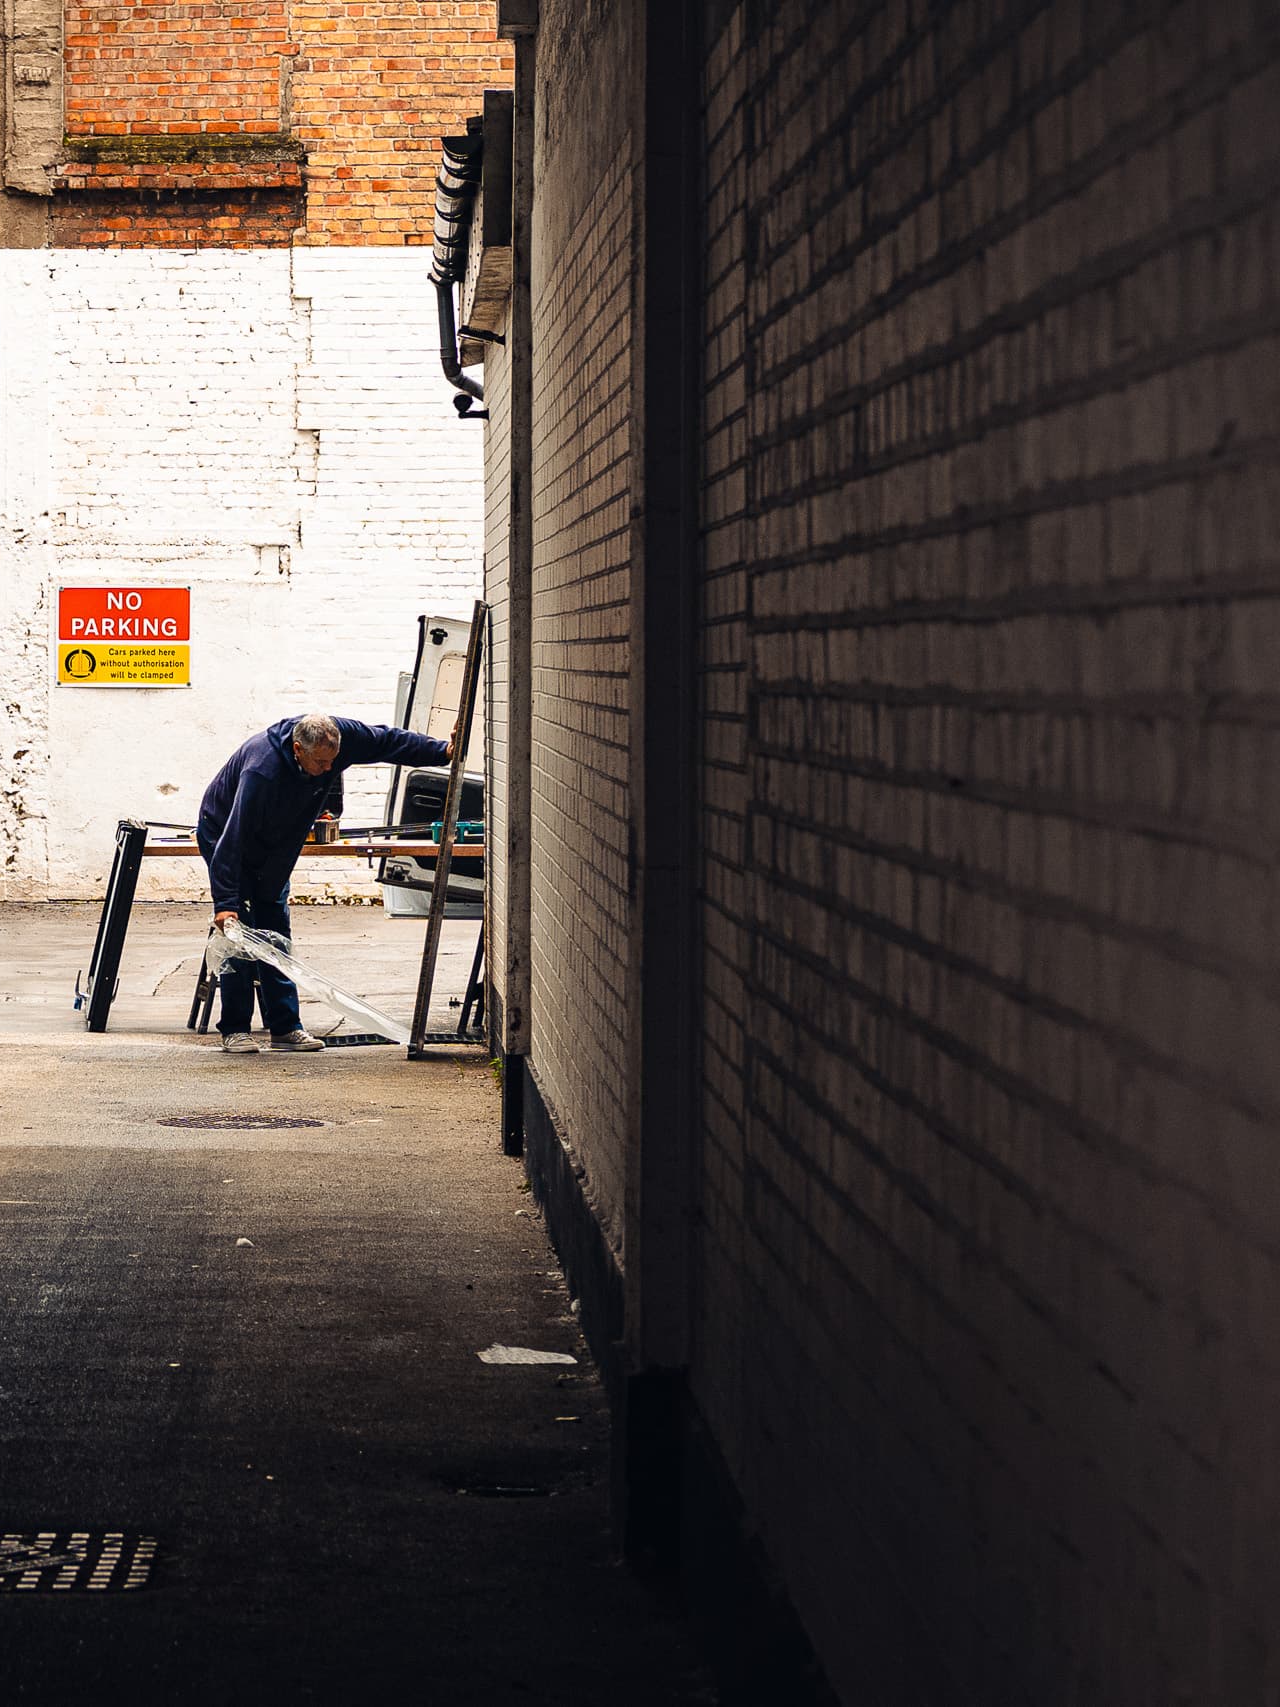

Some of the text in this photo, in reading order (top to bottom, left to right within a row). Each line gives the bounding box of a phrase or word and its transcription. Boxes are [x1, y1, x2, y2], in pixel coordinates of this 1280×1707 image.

[107, 592, 142, 610] NO
[71, 618, 177, 636] PARKING
[108, 648, 176, 657] Cars parked here
[110, 671, 174, 680] will be clamped
